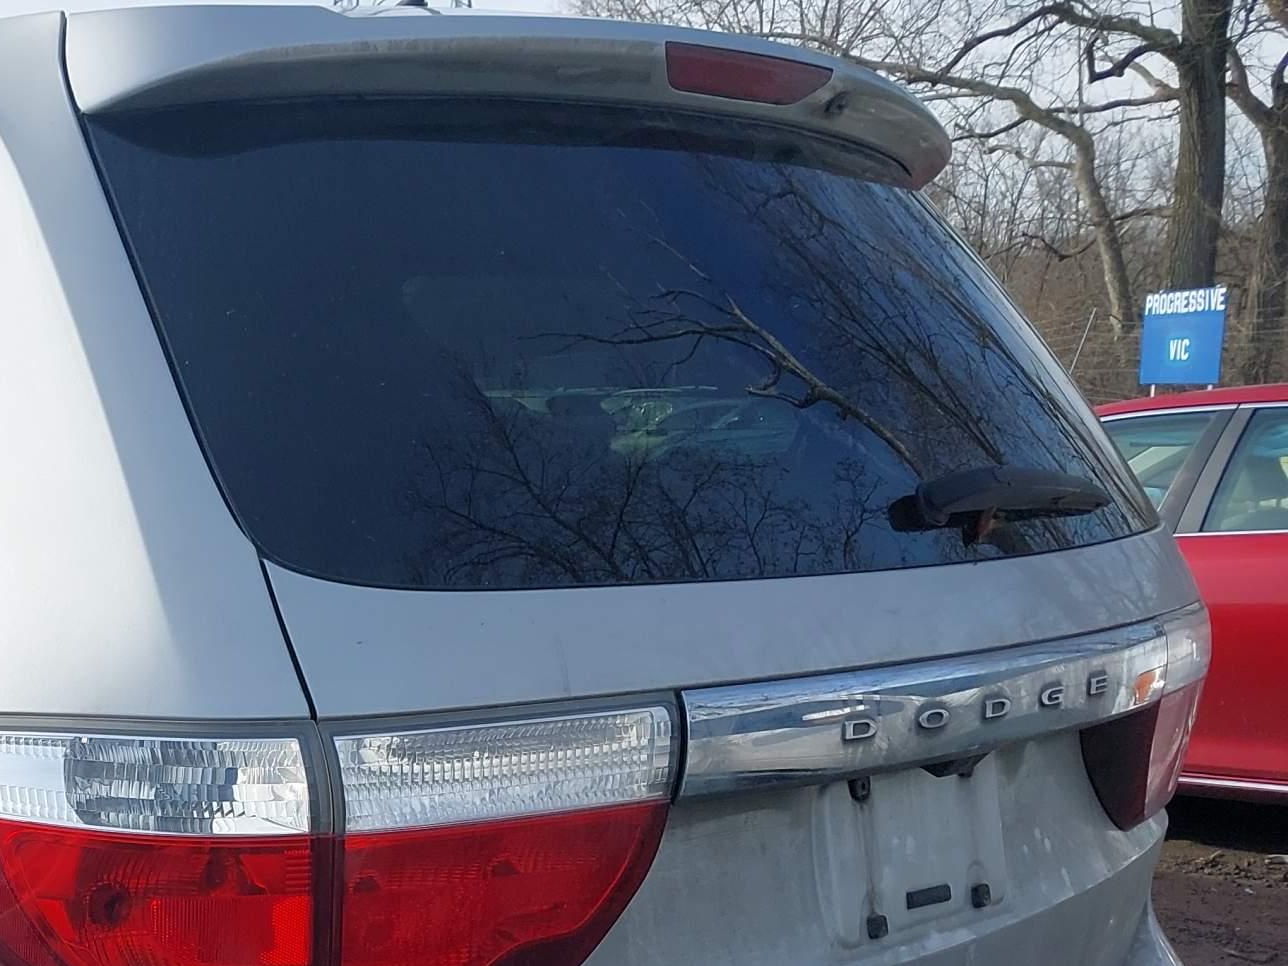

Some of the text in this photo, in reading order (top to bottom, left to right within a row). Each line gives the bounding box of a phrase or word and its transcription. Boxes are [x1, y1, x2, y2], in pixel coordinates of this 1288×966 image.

[1144, 286, 1227, 315] PROGRESSIVE
[1169, 338, 1190, 361] VIC
[843, 674, 1109, 741] DODGE
